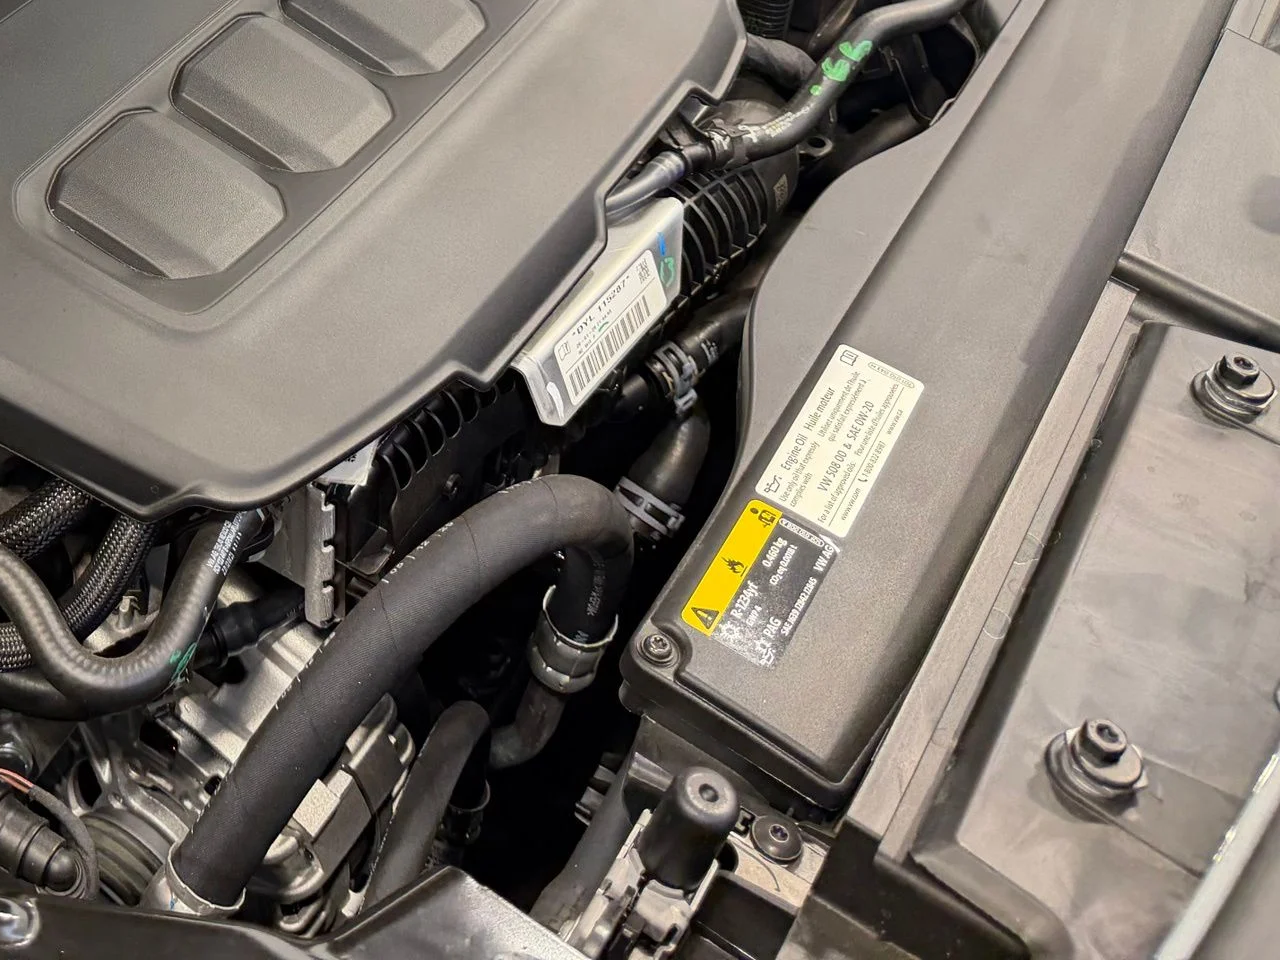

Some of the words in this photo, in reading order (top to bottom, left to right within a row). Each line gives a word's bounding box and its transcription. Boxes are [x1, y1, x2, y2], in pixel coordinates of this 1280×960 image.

[802, 410, 821, 431] Huile
[815, 386, 835, 412] moteur
[854, 400, 875, 426] 0W-20
[846, 423, 862, 441] SAE
[780, 444, 804, 472] Engine
[794, 432, 808, 446] Oil
[842, 440, 852, 449] &
[832, 448, 847, 463] 00
[825, 460, 841, 477] 508
[816, 473, 833, 492] VW
[820, 543, 835, 559] AG
[813, 556, 828, 572] VW
[730, 581, 760, 619] R-1234yf
[761, 545, 780, 567] 0.460
[772, 535, 787, 549] kg
[762, 616, 782, 637] PAG
